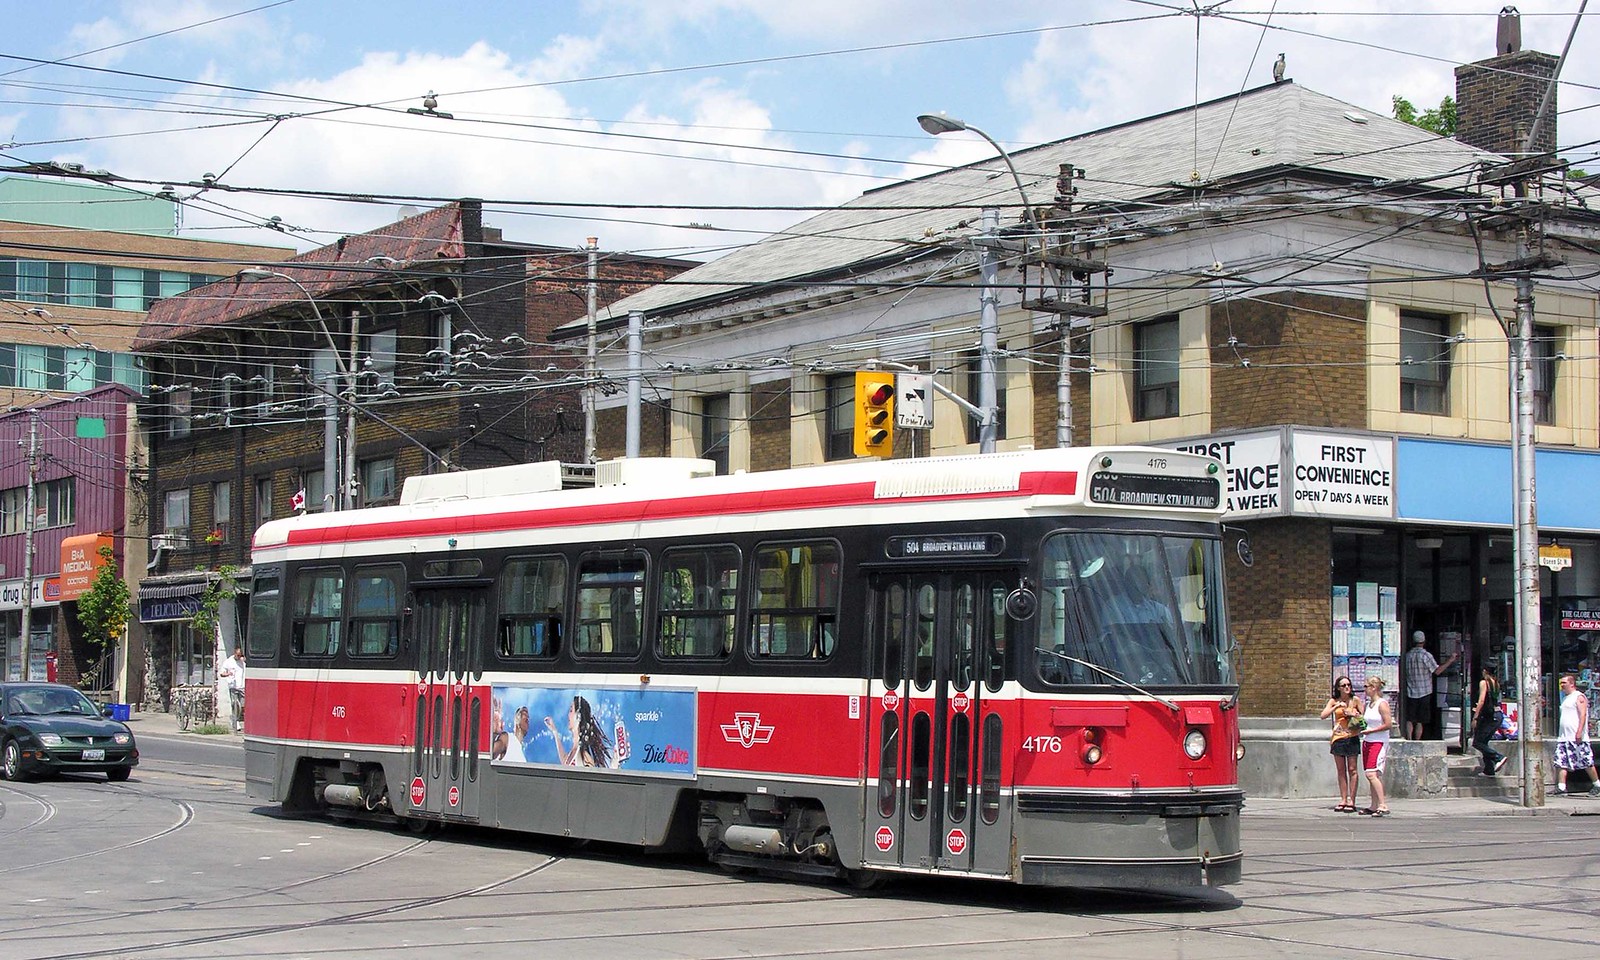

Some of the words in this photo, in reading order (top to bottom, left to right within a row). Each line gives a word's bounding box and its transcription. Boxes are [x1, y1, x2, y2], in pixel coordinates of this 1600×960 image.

[1321, 445, 1366, 463] FIRST
[1148, 459, 1167, 469] 4176
[1226, 464, 1279, 492] ENCE
[1295, 465, 1390, 486] CONVENIENCE
[1093, 487, 1116, 502] 504
[1120, 492, 1166, 505] BROADVIEW
[1195, 496, 1215, 507] KING
[1237, 493, 1278, 511] WEEK
[1294, 490, 1320, 501] OPEN
[1321, 489, 1328, 502] 7
[1330, 492, 1352, 504] DAYS
[1354, 494, 1361, 504] A
[1363, 494, 1389, 506] WEEK
[906, 541, 919, 554] 504
[922, 542, 952, 552] BROADVIEW
[972, 541, 986, 551] KING
[63, 560, 93, 573] MEDICAL
[3, 585, 19, 604] drug
[1573, 611, 1592, 619] GLOBE
[884, 695, 897, 705] STOP
[954, 697, 967, 707] STOP
[331, 706, 346, 718] 4176
[634, 710, 660, 723] sparkle
[1022, 736, 1062, 753] 4176
[412, 786, 424, 797] STOP
[877, 834, 892, 844] STOP
[949, 836, 964, 848] STOP
